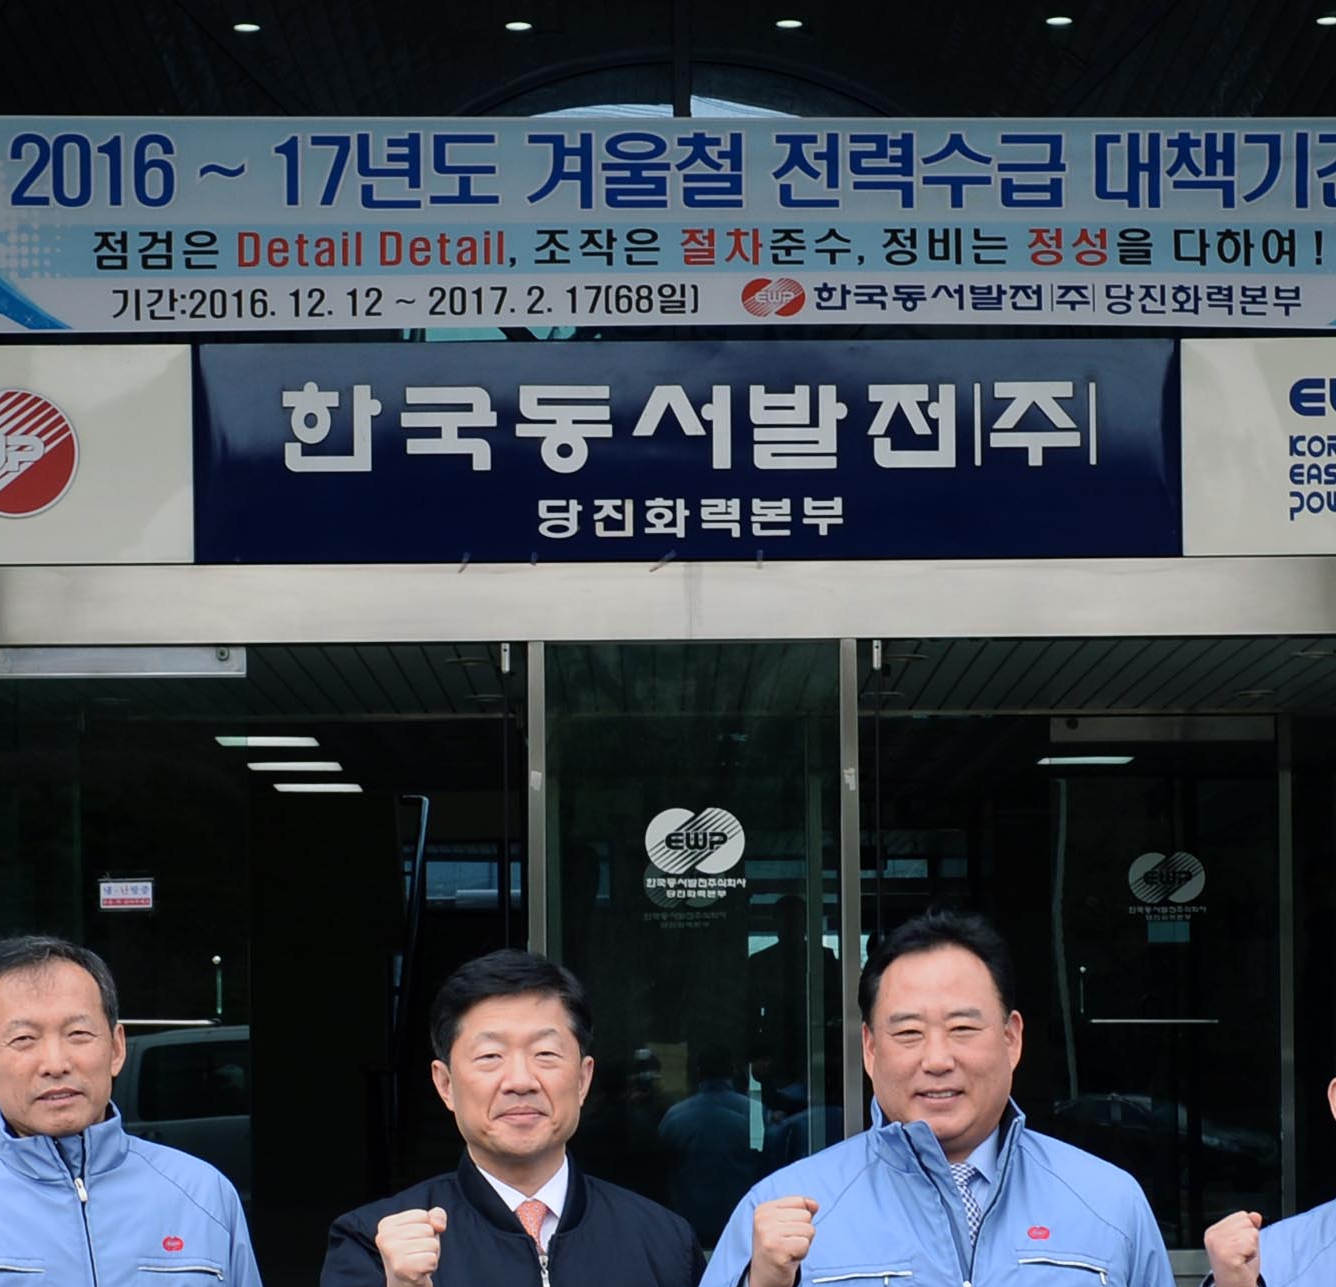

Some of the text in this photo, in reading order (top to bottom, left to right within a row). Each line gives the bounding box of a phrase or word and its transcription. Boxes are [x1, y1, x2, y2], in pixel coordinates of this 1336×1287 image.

[9, 132, 176, 208] 2016
[274, 131, 500, 210] 17년도
[526, 131, 744, 210] 겨울철
[771, 131, 1067, 210] 전력수급
[92, 230, 220, 271] 점검은
[236, 230, 363, 269] Detail
[378, 230, 517, 269] Detail,
[533, 228, 662, 267] 조작은
[679, 228, 865, 267] 절차준수,
[881, 227, 1009, 267] 정비는
[1027, 227, 1154, 267] 정성을
[345, 286, 384, 317] 12
[427, 285, 516, 317] 2017.
[1104, 283, 1303, 317] 당진화력본부
[536, 495, 845, 539] 당진화력본부
[664, 831, 728, 852] EWP
